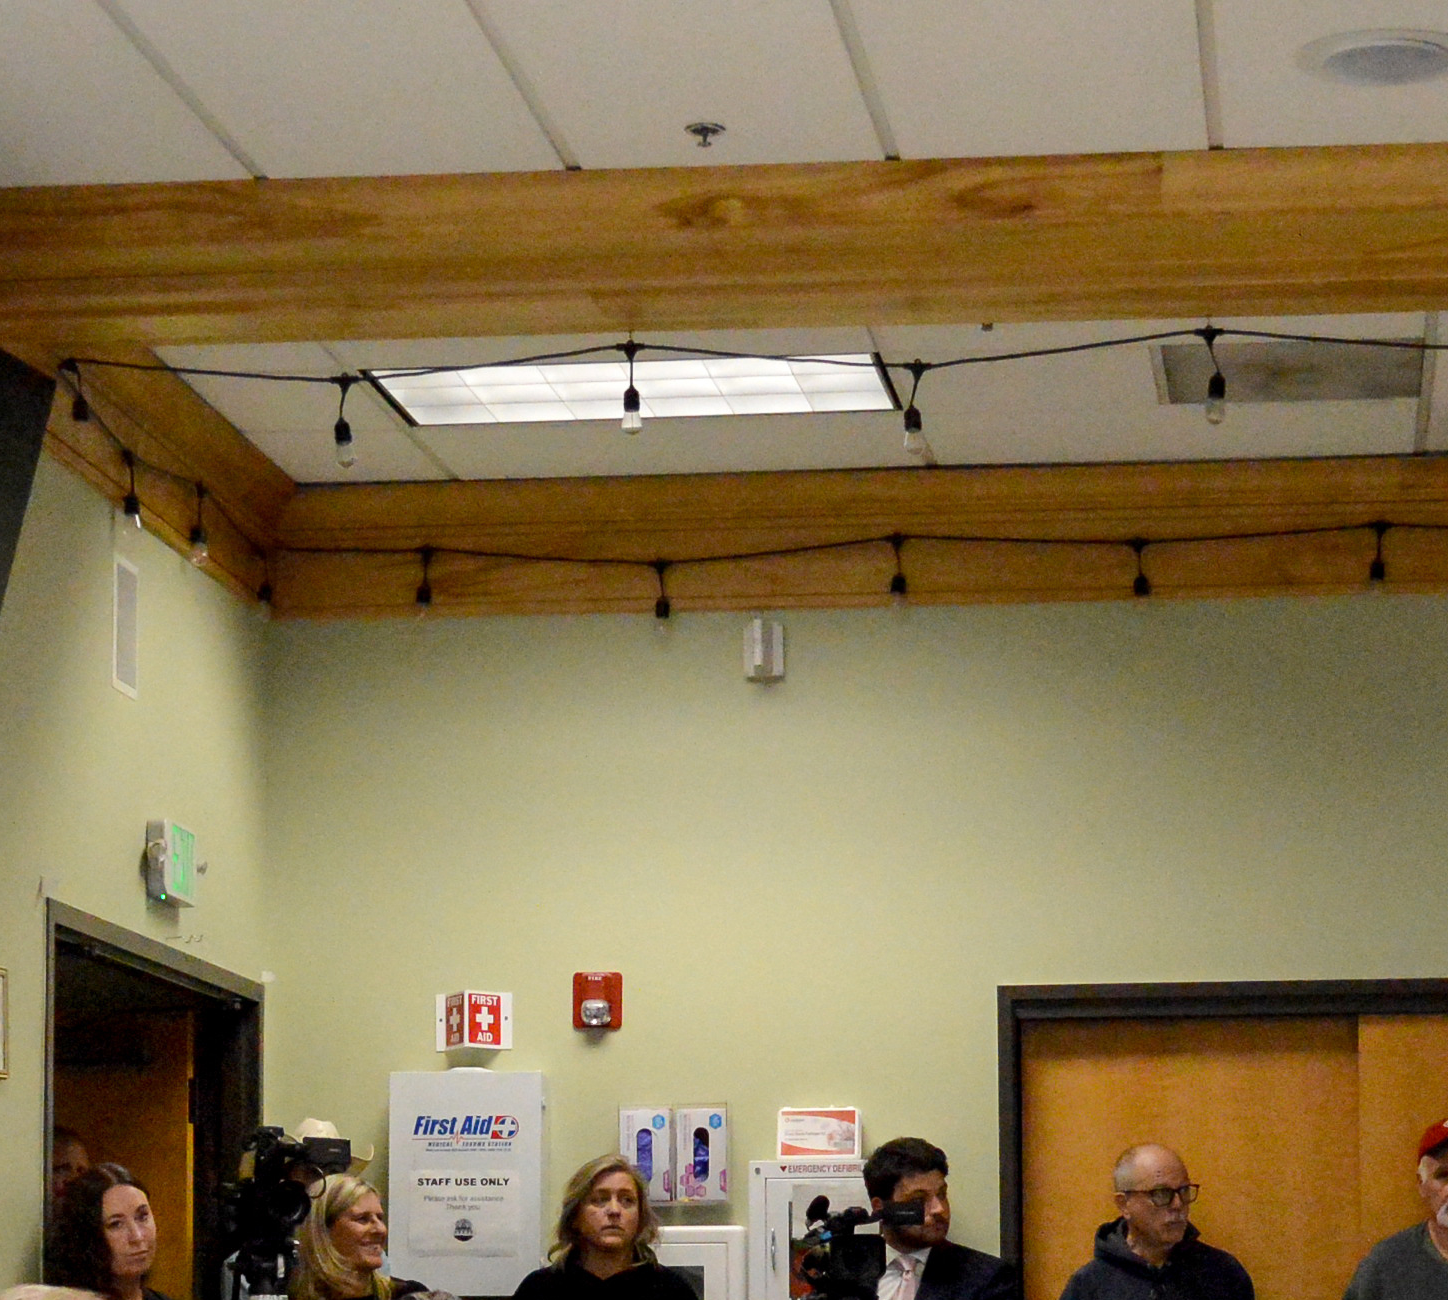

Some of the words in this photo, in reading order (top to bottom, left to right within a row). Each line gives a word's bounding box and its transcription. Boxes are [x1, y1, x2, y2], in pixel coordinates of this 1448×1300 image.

[471, 994, 499, 1007] FIRST
[476, 1032, 494, 1043] AID
[413, 1115, 458, 1136] First
[459, 1115, 494, 1136] Aid
[788, 1164, 832, 1174] EMERGENCY
[417, 1177, 452, 1187] STAFF
[454, 1177, 477, 1187] USE
[480, 1177, 510, 1187] ONLY
